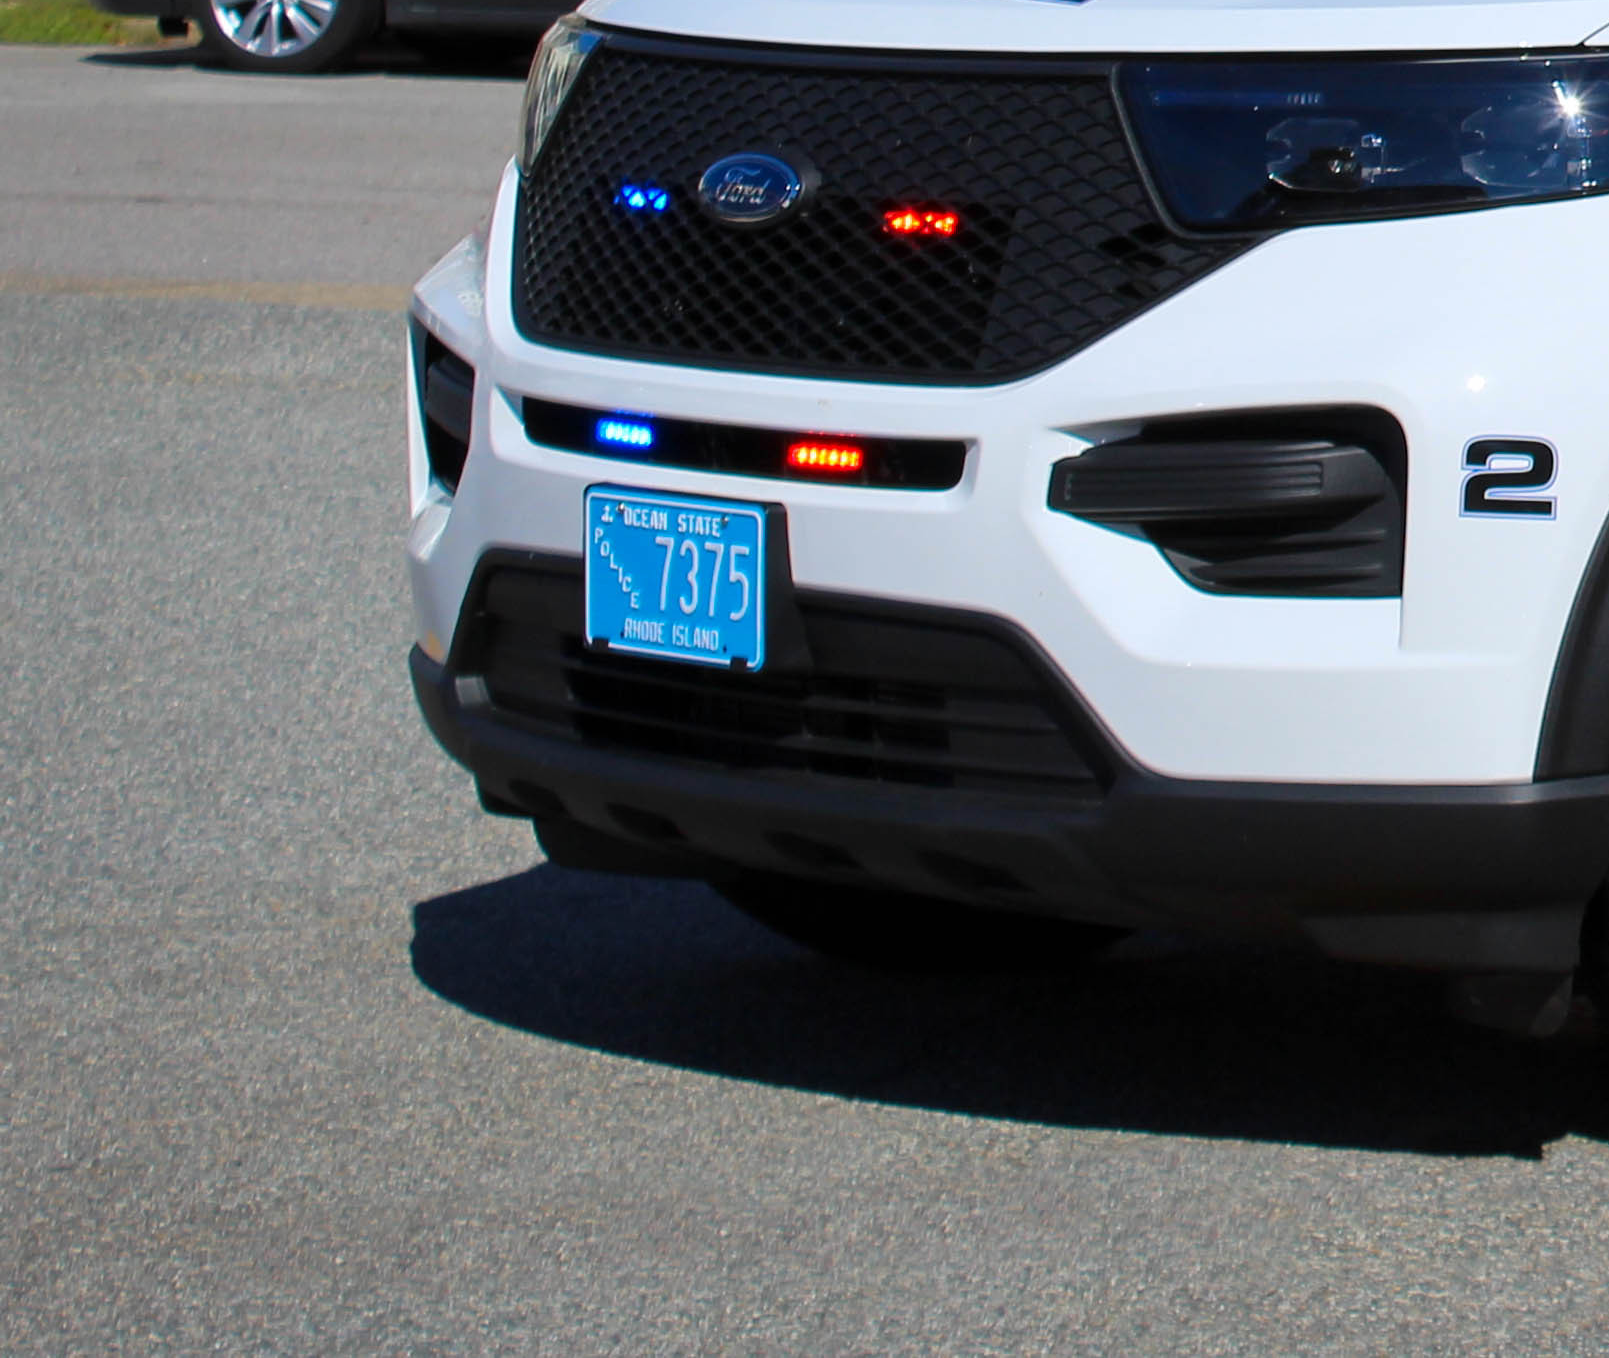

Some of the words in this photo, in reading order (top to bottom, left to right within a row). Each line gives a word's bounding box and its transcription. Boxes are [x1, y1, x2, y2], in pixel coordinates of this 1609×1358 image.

[716, 167, 770, 204] Ford
[1459, 434, 1559, 520] 2
[623, 505, 668, 531] OCEAN
[677, 513, 721, 538] STATE
[594, 527, 640, 609] POLICE
[655, 535, 750, 621] 7375
[624, 617, 665, 645] RHODE
[672, 624, 719, 651] ISLAND
